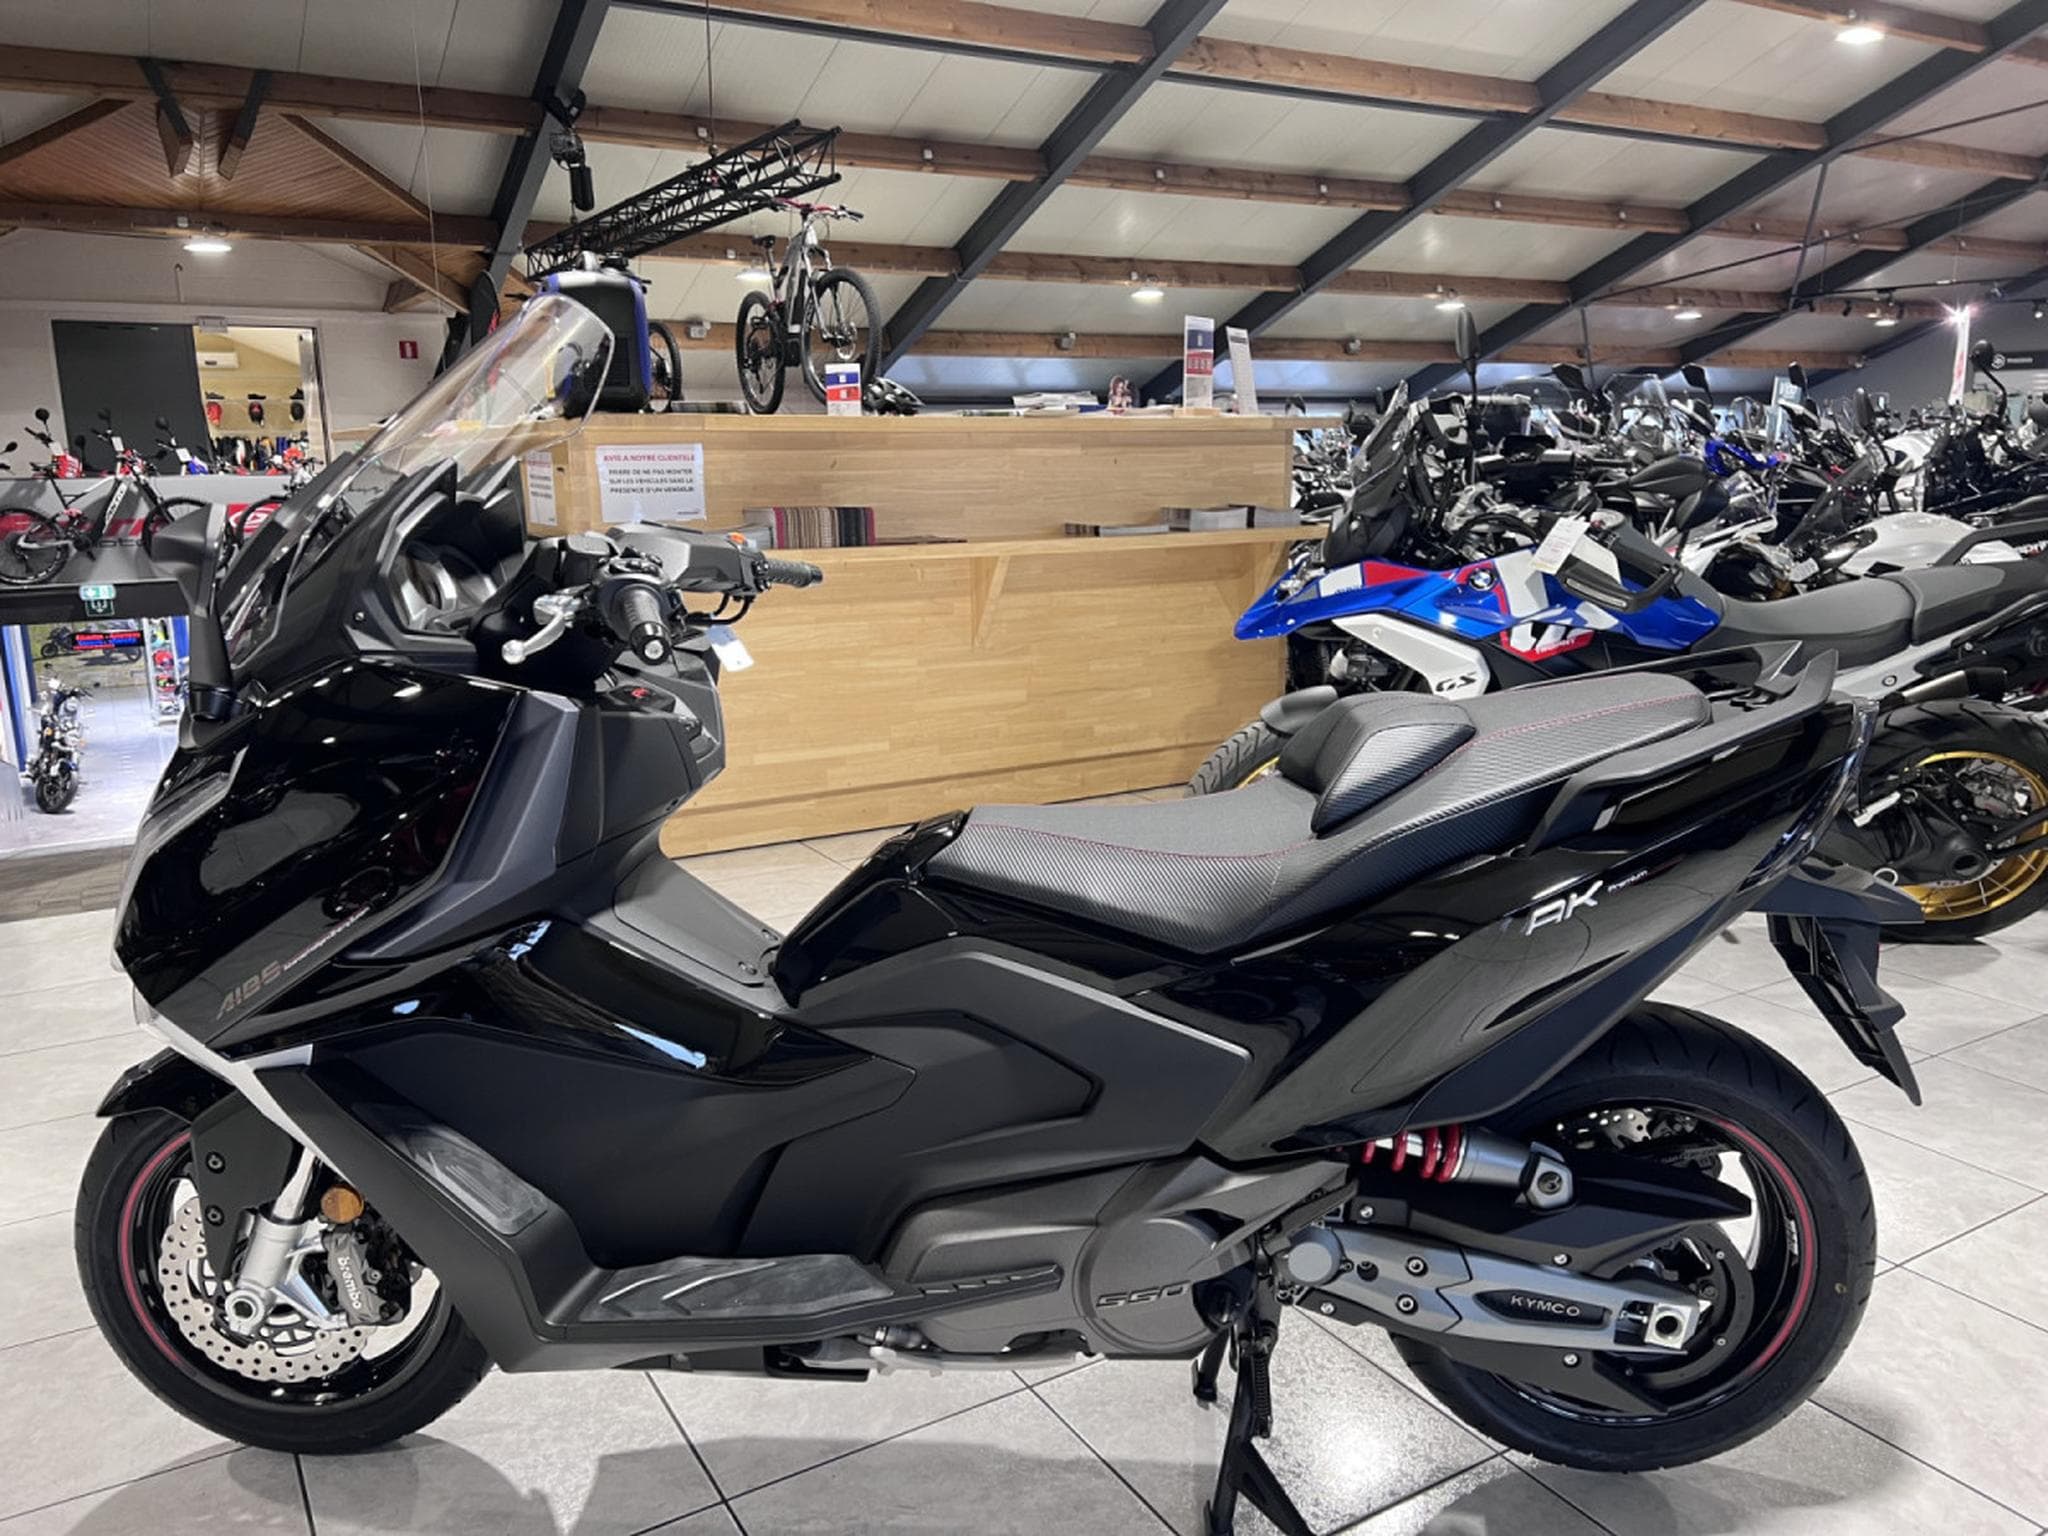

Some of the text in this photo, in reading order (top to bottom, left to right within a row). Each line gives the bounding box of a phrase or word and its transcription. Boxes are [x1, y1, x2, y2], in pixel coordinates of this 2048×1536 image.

[1435, 671, 1478, 693] GS
[1525, 880, 1604, 936] AK
[337, 1255, 362, 1310] brembo
[1096, 1279, 1191, 1308] 550
[1511, 1294, 1580, 1317] KYMCO
